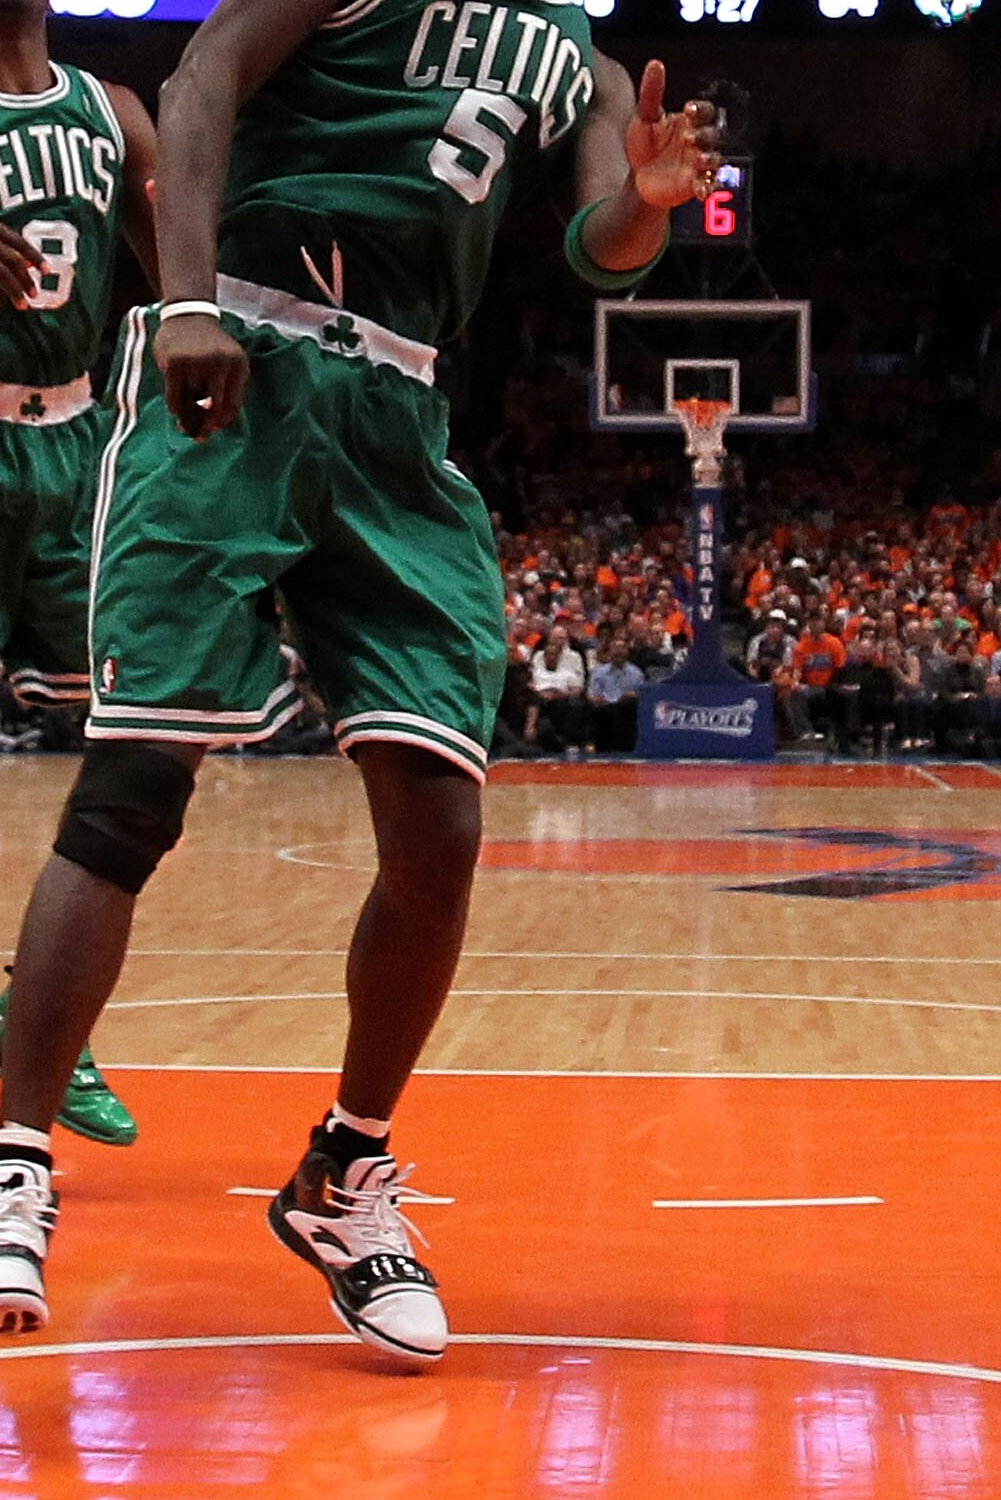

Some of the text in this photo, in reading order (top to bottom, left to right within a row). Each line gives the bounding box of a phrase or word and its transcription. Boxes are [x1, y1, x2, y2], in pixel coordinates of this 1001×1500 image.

[402, 0, 595, 149] CELTICS
[427, 87, 528, 206] 5
[703, 190, 736, 236] 6
[21, 219, 79, 310] 8
[698, 532, 715, 621] NBA TV
